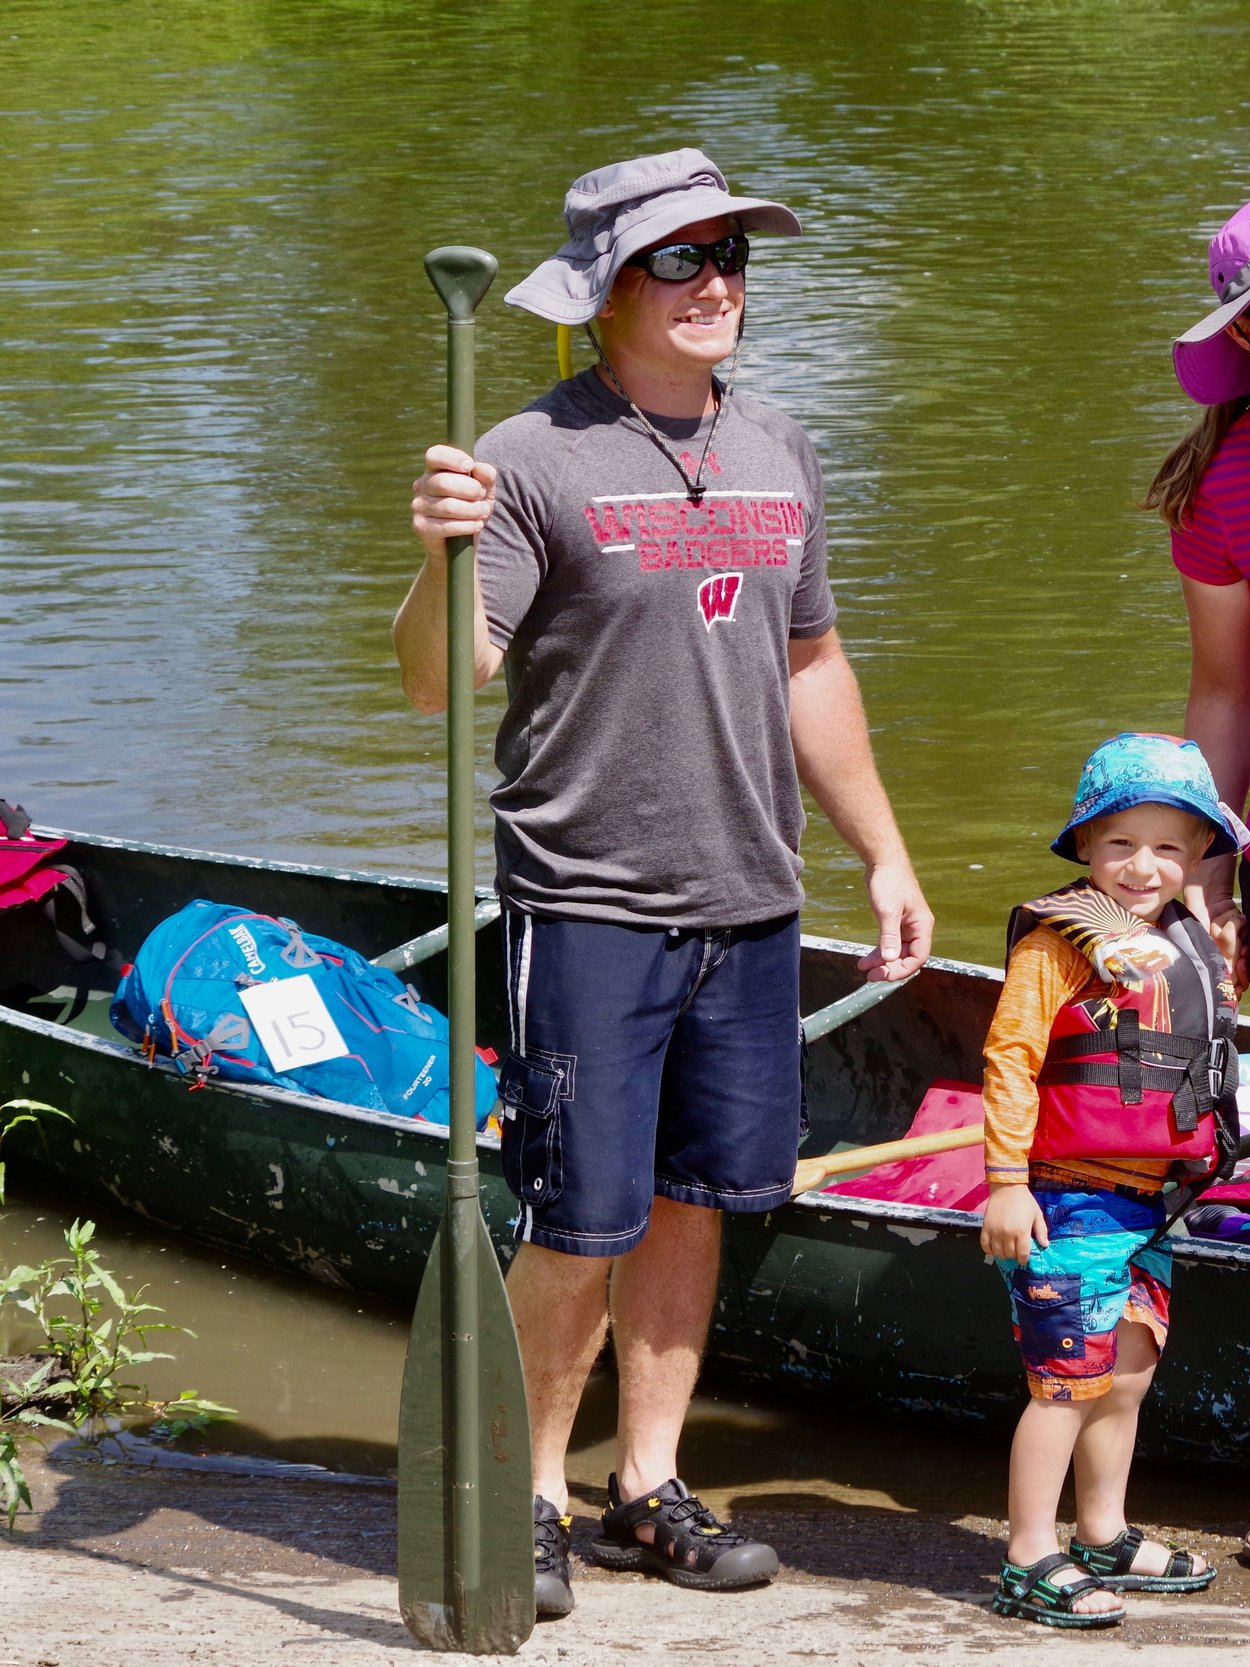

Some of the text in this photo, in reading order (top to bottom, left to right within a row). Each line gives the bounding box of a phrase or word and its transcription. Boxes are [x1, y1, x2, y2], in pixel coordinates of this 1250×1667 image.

[584, 500, 804, 543] WISCONSIN
[638, 539, 788, 572] BADGERS
[698, 573, 743, 633] W
[228, 923, 266, 975] CAMELBAK
[270, 1011, 326, 1058] 15
[402, 1054, 437, 1100] FOURTEENER
[422, 1076, 432, 1087] 20
